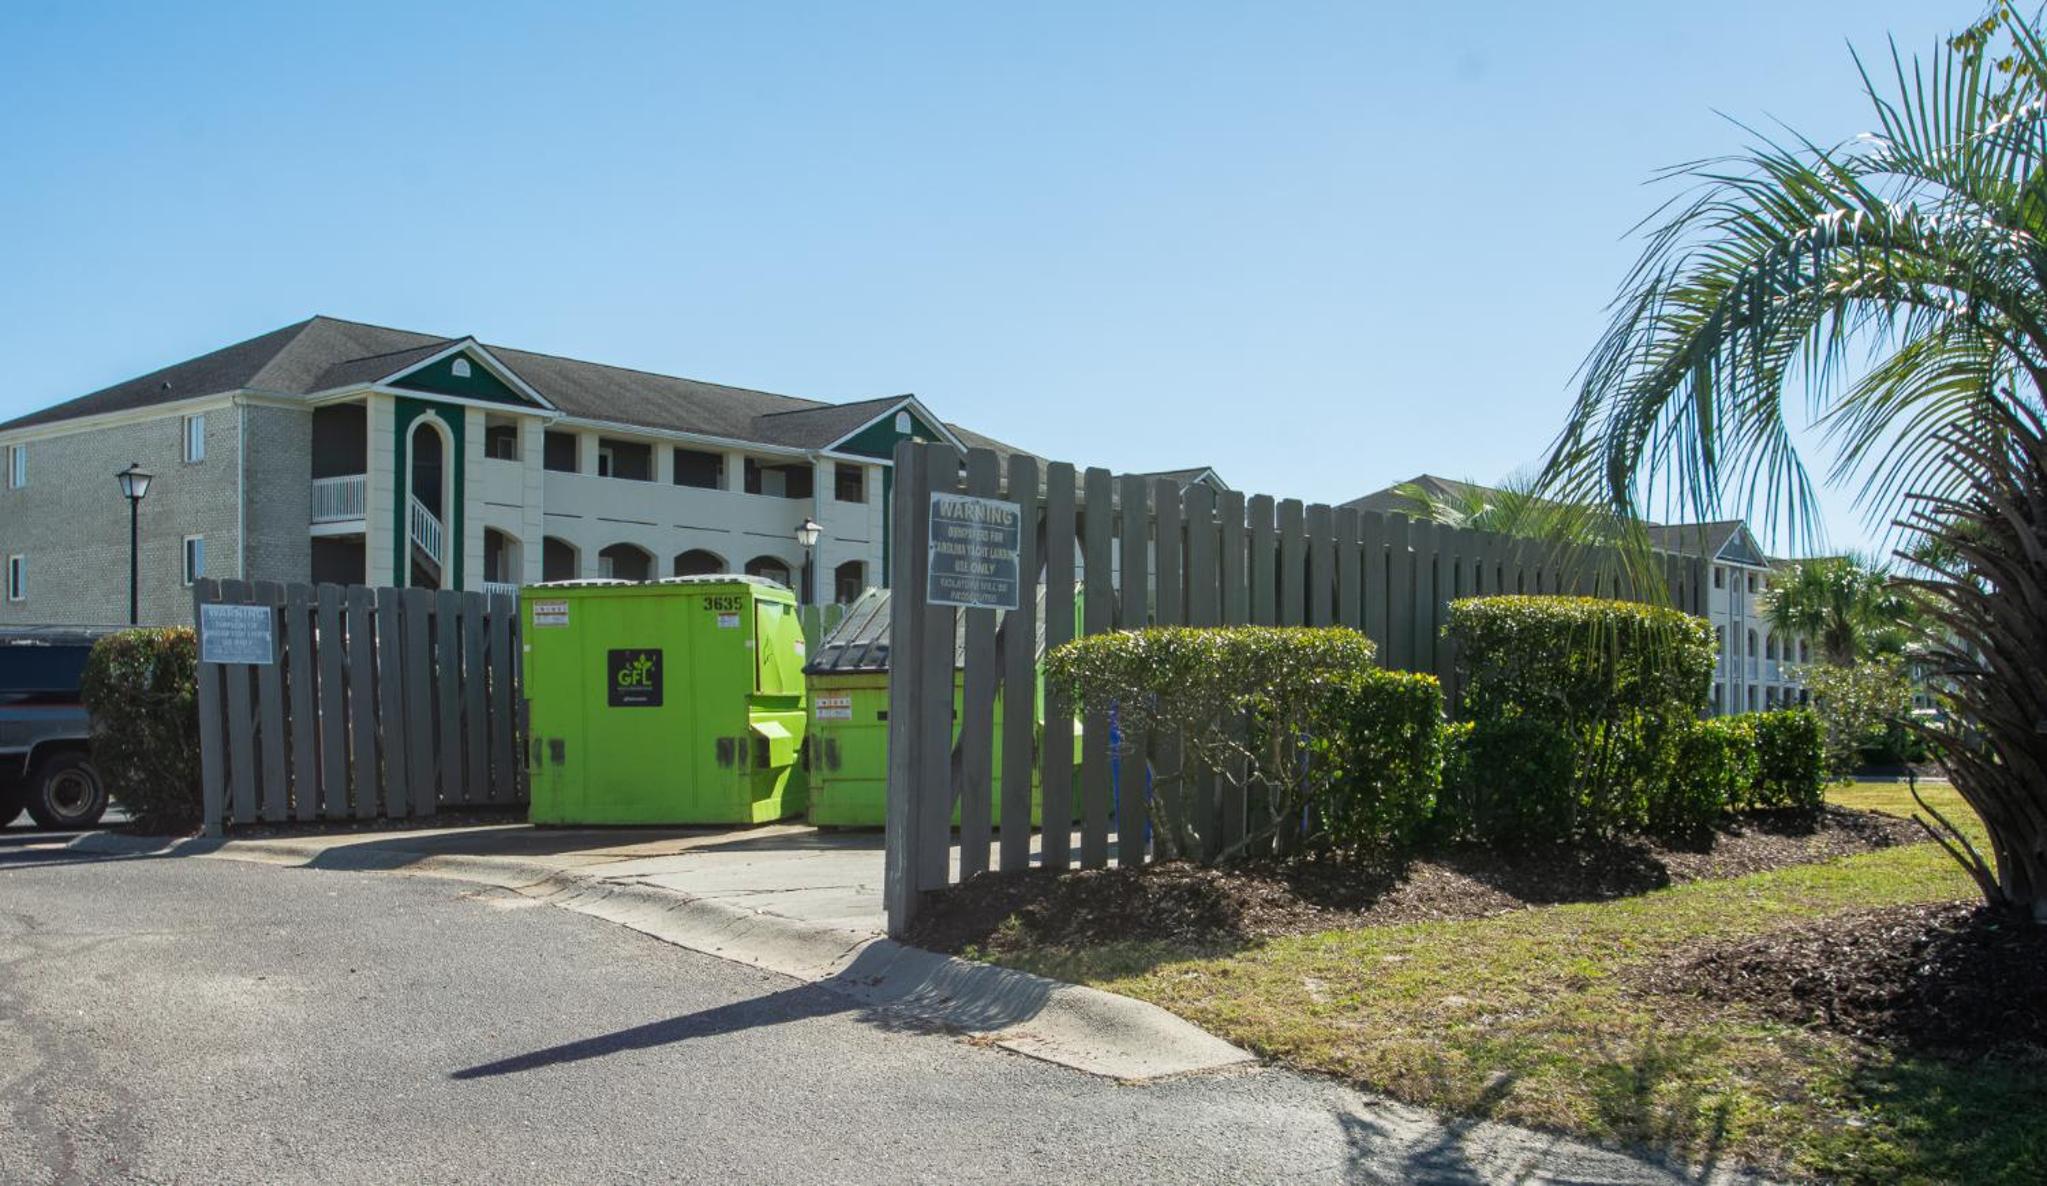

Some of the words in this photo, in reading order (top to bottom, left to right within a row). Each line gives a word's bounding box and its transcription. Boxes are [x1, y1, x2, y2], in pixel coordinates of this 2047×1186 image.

[940, 500, 1013, 525] WARNING
[970, 561, 997, 575] ONLY
[703, 597, 743, 611] 3635
[618, 667, 652, 686] GFL
